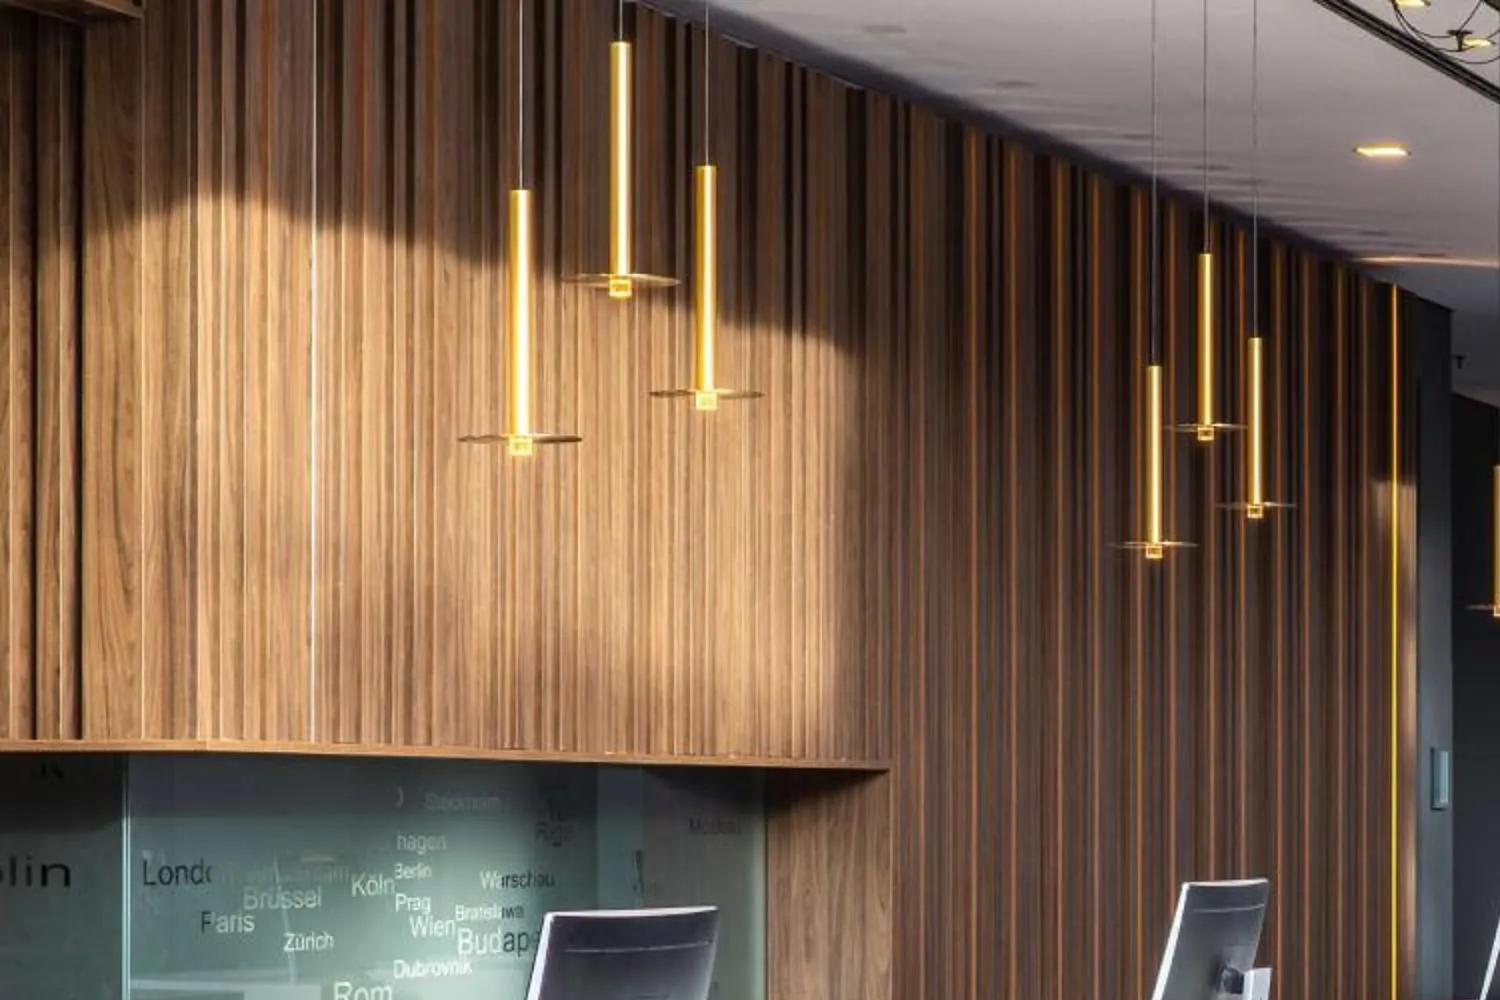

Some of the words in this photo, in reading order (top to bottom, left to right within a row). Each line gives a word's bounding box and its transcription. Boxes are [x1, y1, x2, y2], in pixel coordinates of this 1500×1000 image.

[396, 834, 447, 855] hagen
[0, 855, 71, 887] lin
[142, 858, 228, 886] Lond
[394, 861, 432, 880] Berlin
[479, 868, 556, 890] Warschau
[351, 873, 396, 897] Köln
[243, 885, 322, 911] Brüssel
[395, 893, 432, 914] Prag
[200, 910, 256, 934] Paris
[409, 915, 456, 938] Wien
[283, 931, 334, 952] Zürich
[393, 956, 473, 980] Dubrovnik
